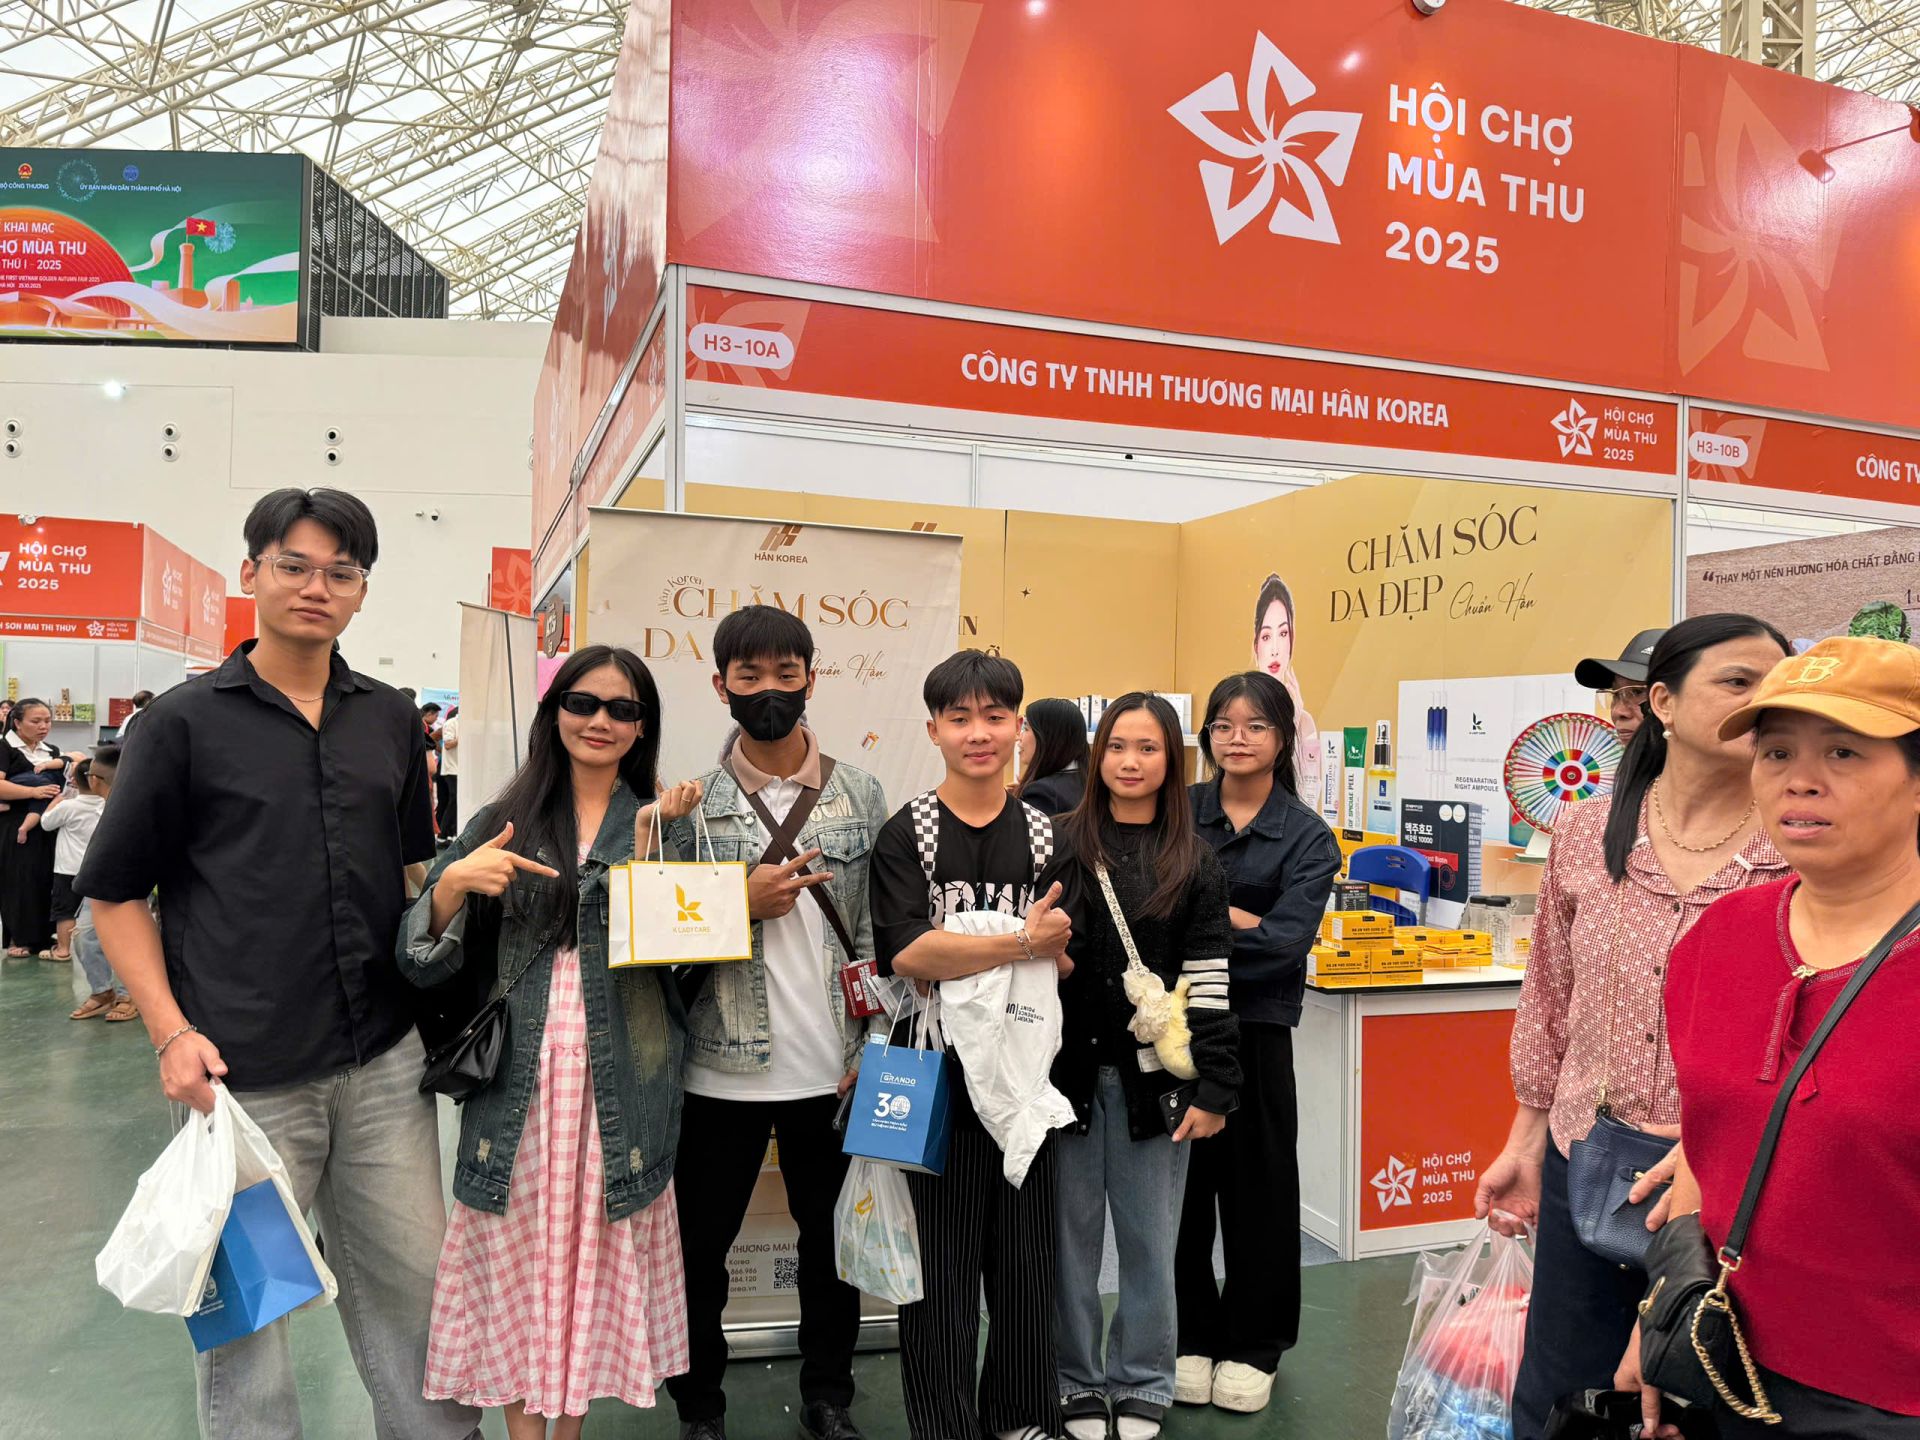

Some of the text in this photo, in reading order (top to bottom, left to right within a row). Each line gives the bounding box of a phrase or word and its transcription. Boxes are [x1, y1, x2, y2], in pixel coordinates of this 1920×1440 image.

[1389, 82, 1573, 167] HỘI CHỢ
[1387, 148, 1585, 223] MÙA THU
[4, 222, 54, 234] KHAI MẠC
[22, 238, 54, 254] MÙA
[58, 241, 86, 255] THU
[1385, 221, 1500, 274] 2025
[37, 260, 62, 270] 2025
[703, 334, 780, 359] H3-10A
[960, 349, 1449, 428] CÔNG TY TNHH THƯƠNG MẠI HÂN KOREA
[1604, 406, 1654, 428] HỘI CHỢ
[1604, 426, 1658, 445] MÙA THU
[1603, 448, 1634, 462] 2025
[1696, 440, 1740, 458] H3-10B
[1856, 454, 1900, 481] CÔNG
[1347, 502, 1538, 574] CHĂM SÓC
[18, 540, 88, 560] HỘI CHỢ
[776, 554, 808, 564] KOREA
[18, 558, 92, 574] MÙA THU
[1742, 569, 1761, 584] MỘT
[1786, 562, 1823, 577] HƯƠNG
[1826, 558, 1849, 572] HÓA
[1851, 553, 1880, 570] CHẤT
[1883, 550, 1915, 566] BẰNG
[18, 578, 60, 590] 2025
[1330, 572, 1538, 623] DA ĐẸP Chuẩn Hàn
[818, 589, 909, 629] SÓC
[644, 628, 704, 661] DA
[1786, 656, 1842, 684] B
[1454, 783, 1499, 792] NIGHT AMPOULE
[1456, 776, 1498, 785] REGENARATING
[881, 1072, 916, 1084] GRANDO
[1422, 1151, 1472, 1170] HỘI CHỢ
[1422, 1170, 1475, 1186] MÙA THU
[1422, 1190, 1453, 1204] 2025
[732, 1243, 770, 1254] THƯƠNG
[772, 1242, 790, 1254] MẠI
